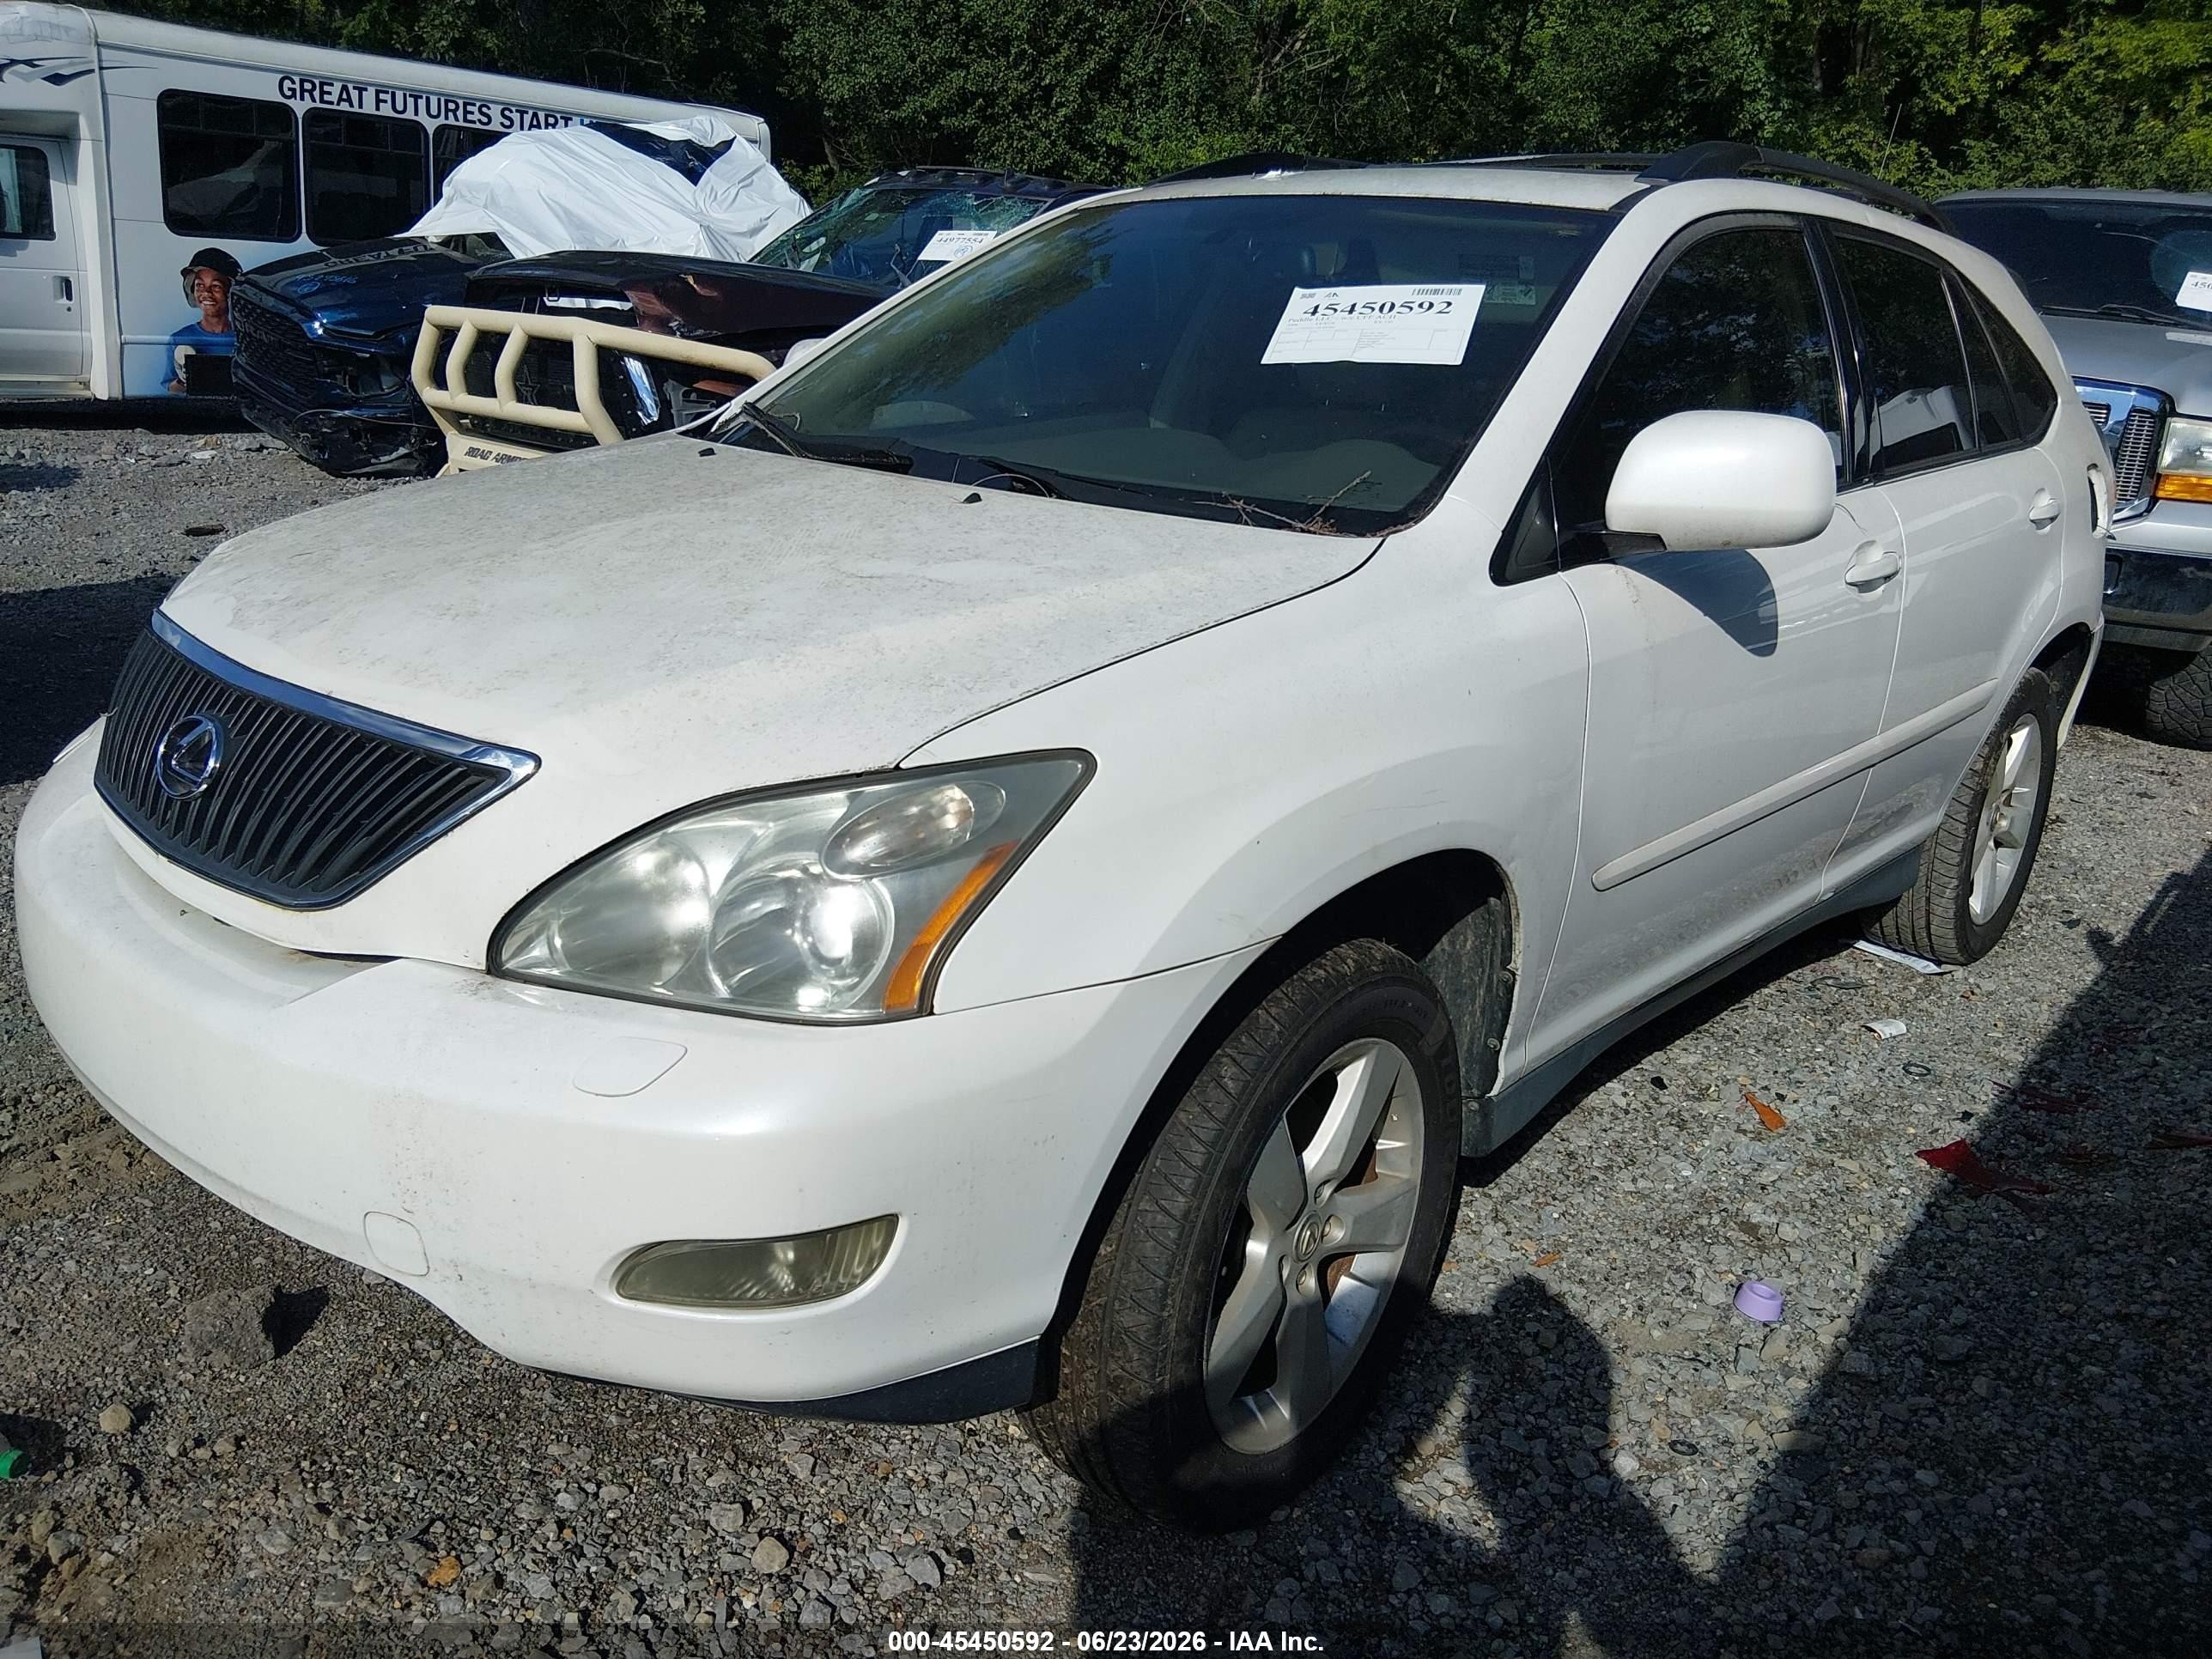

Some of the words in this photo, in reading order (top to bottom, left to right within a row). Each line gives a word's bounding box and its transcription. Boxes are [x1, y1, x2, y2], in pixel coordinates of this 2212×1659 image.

[277, 75, 368, 109] GREAT
[374, 88, 493, 126] FUTURES
[499, 106, 574, 131] START
[1302, 301, 1453, 317] 45450592
[464, 447, 493, 460] ROAD
